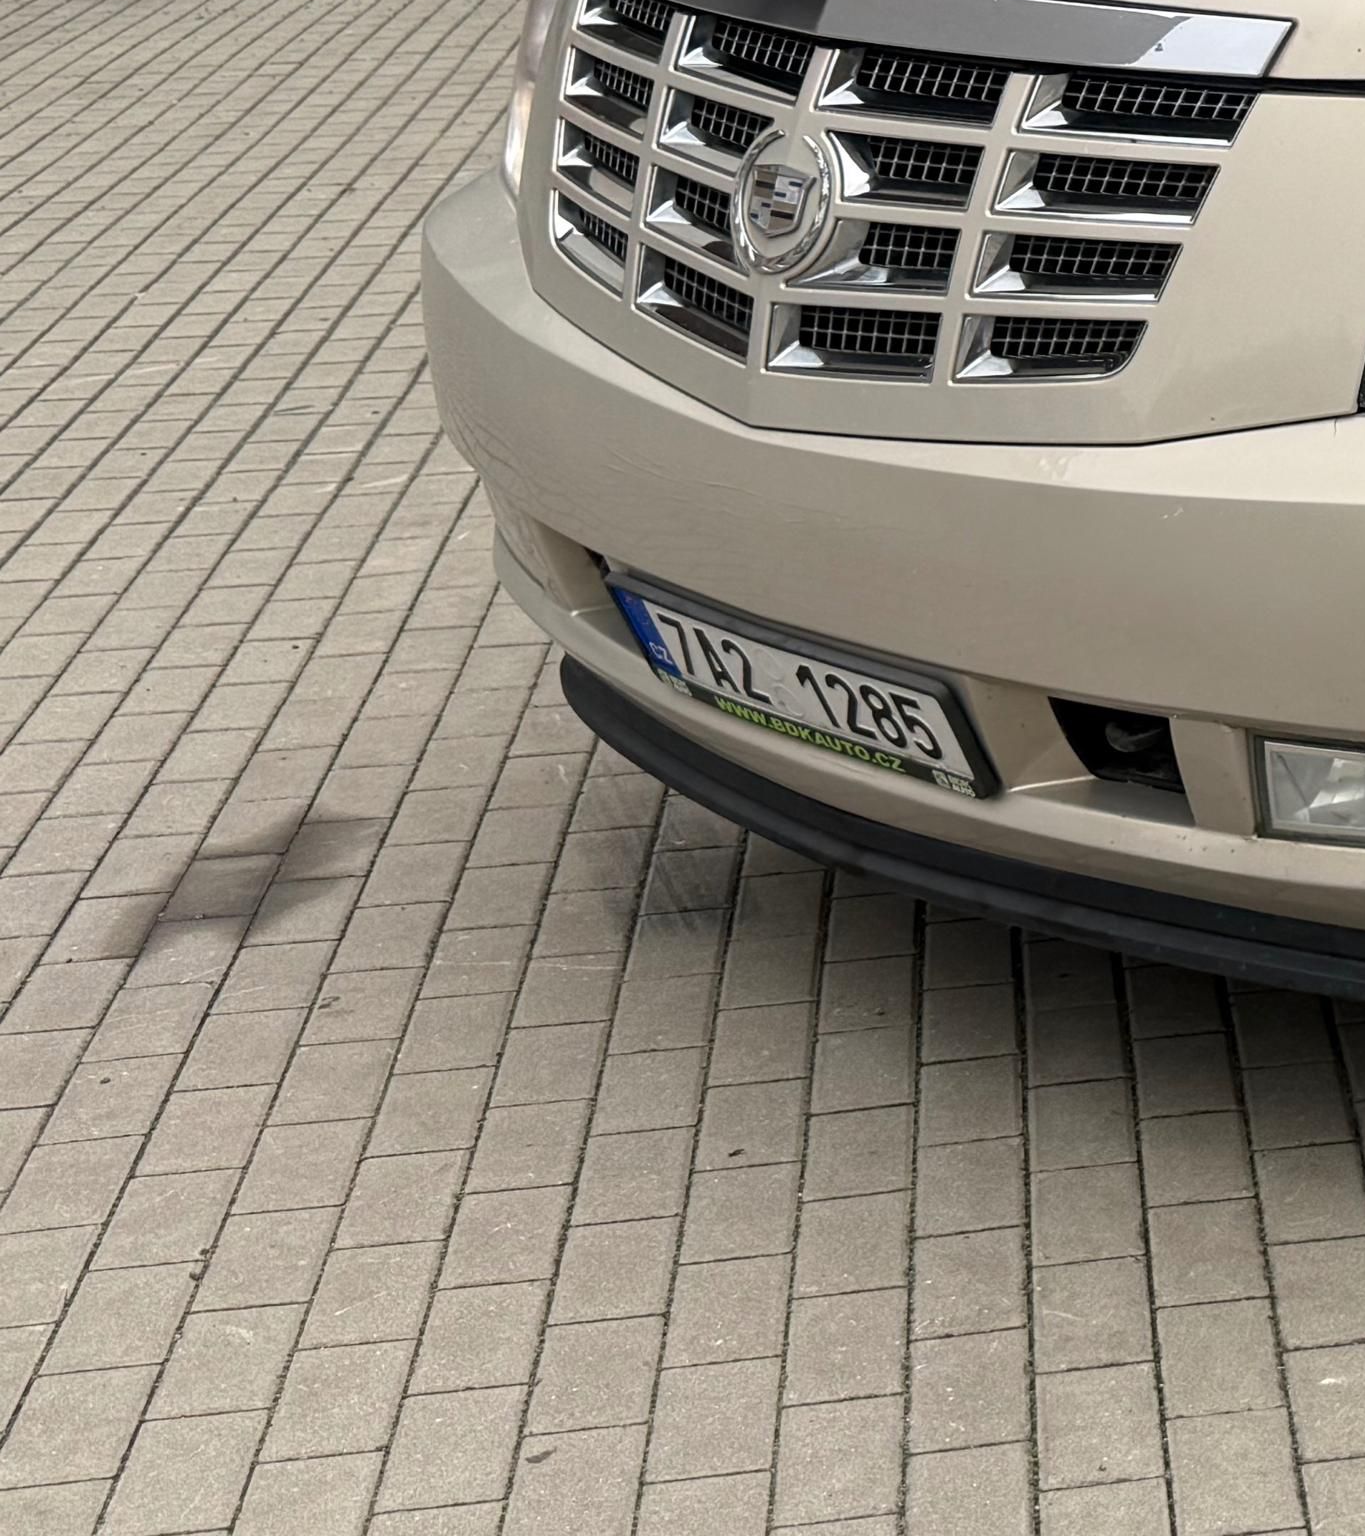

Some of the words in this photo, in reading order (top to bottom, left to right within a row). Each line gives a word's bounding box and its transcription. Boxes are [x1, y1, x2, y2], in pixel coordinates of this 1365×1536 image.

[649, 641, 673, 664] CZ
[656, 612, 773, 705] 7A2
[795, 663, 943, 760] 1285
[714, 695, 907, 773] WWW.BDKAUTO.CZ
